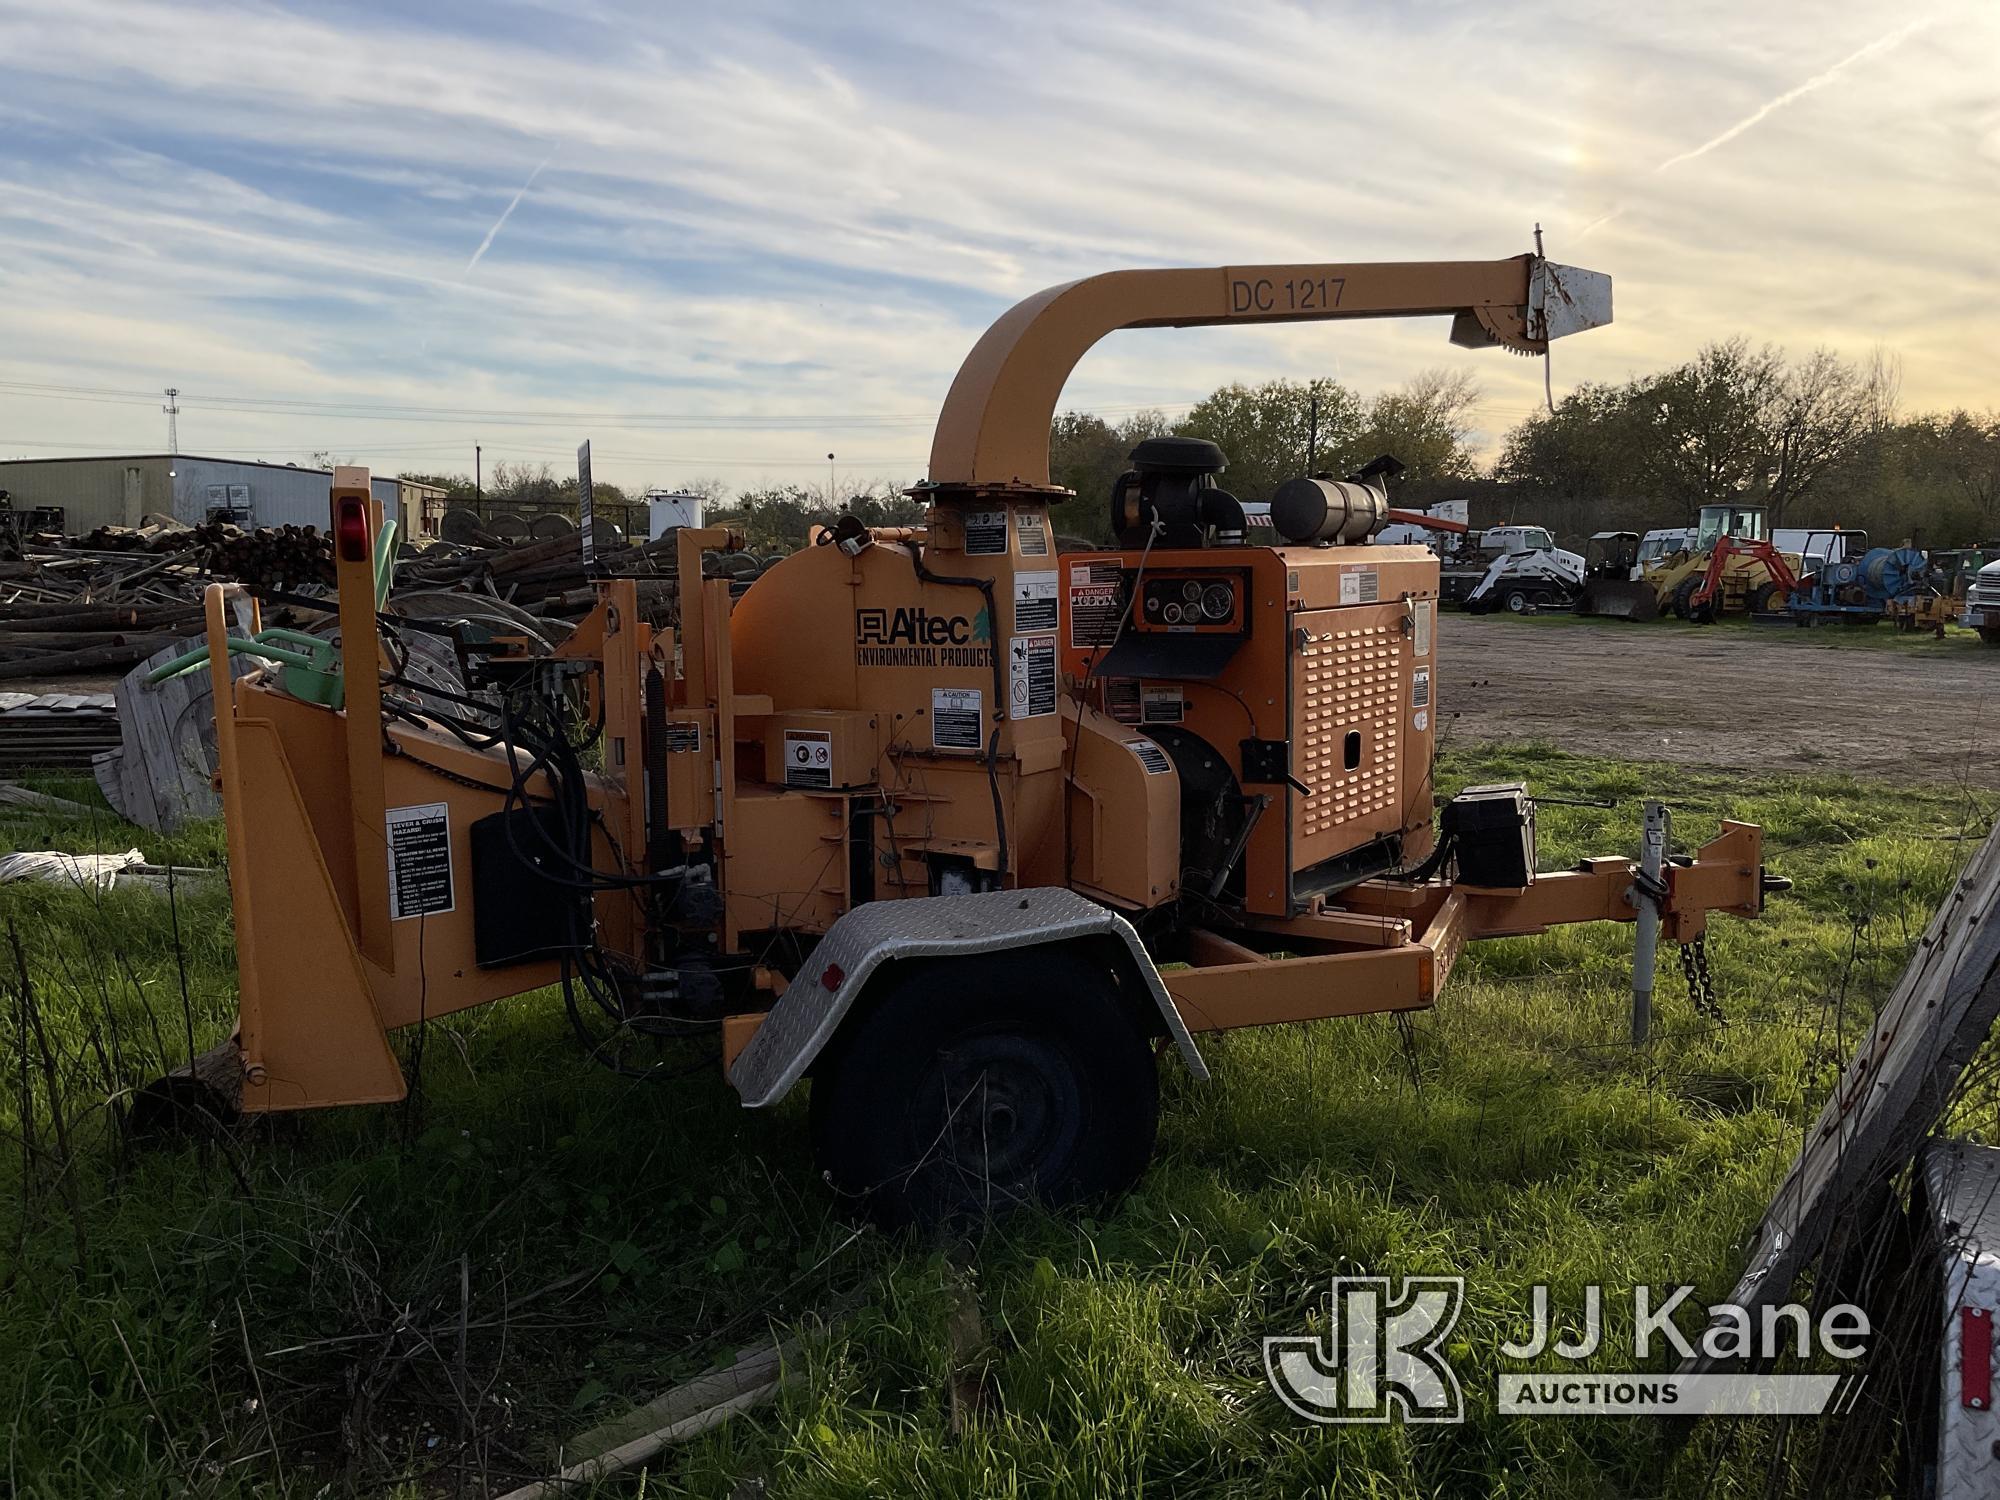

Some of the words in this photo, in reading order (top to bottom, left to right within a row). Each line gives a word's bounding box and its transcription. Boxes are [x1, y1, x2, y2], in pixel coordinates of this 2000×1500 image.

[1232, 279, 1274, 312] DC
[1285, 278, 1346, 309] 1217
[889, 608, 969, 645] Altec
[858, 648, 937, 666] ENVIRONMENTAL
